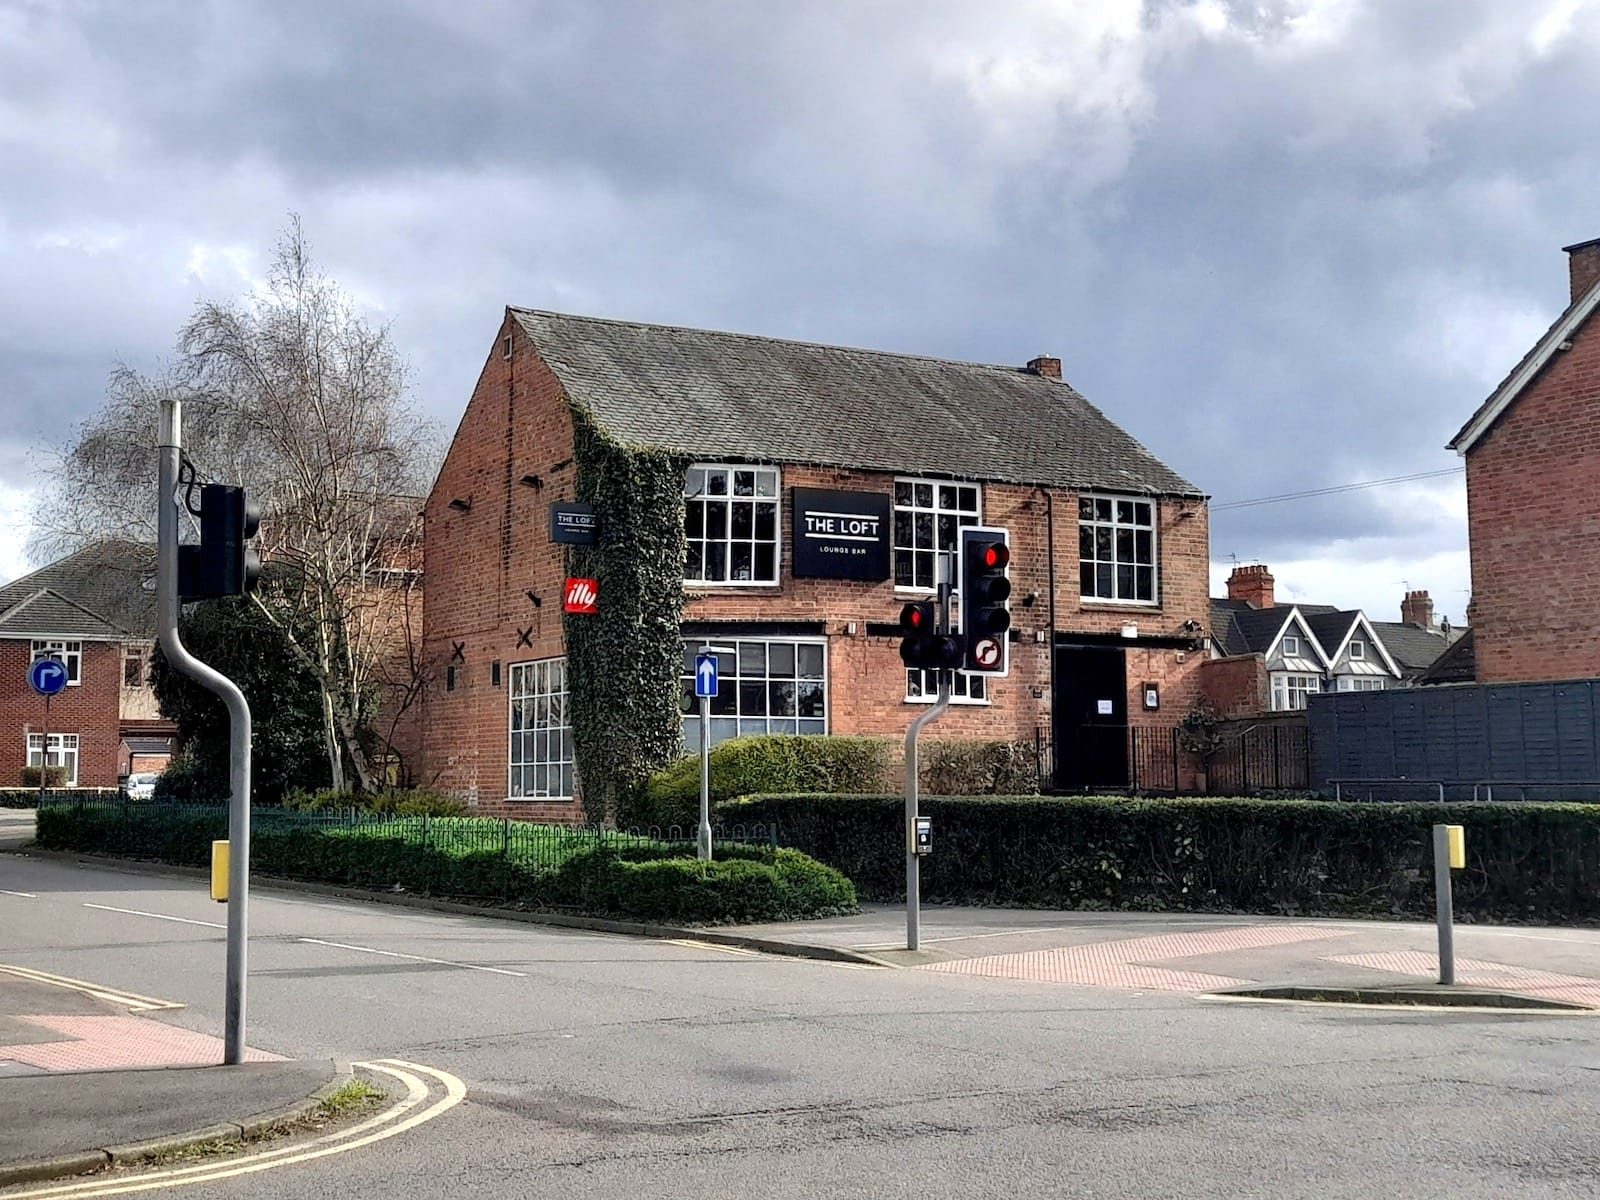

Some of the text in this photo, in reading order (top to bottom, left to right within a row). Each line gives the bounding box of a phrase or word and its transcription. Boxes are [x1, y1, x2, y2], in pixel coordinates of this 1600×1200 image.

[557, 515, 573, 523] THE
[805, 517, 879, 535] THE LOFT
[820, 546, 849, 554] LOUNGE
[567, 583, 597, 610] illy
